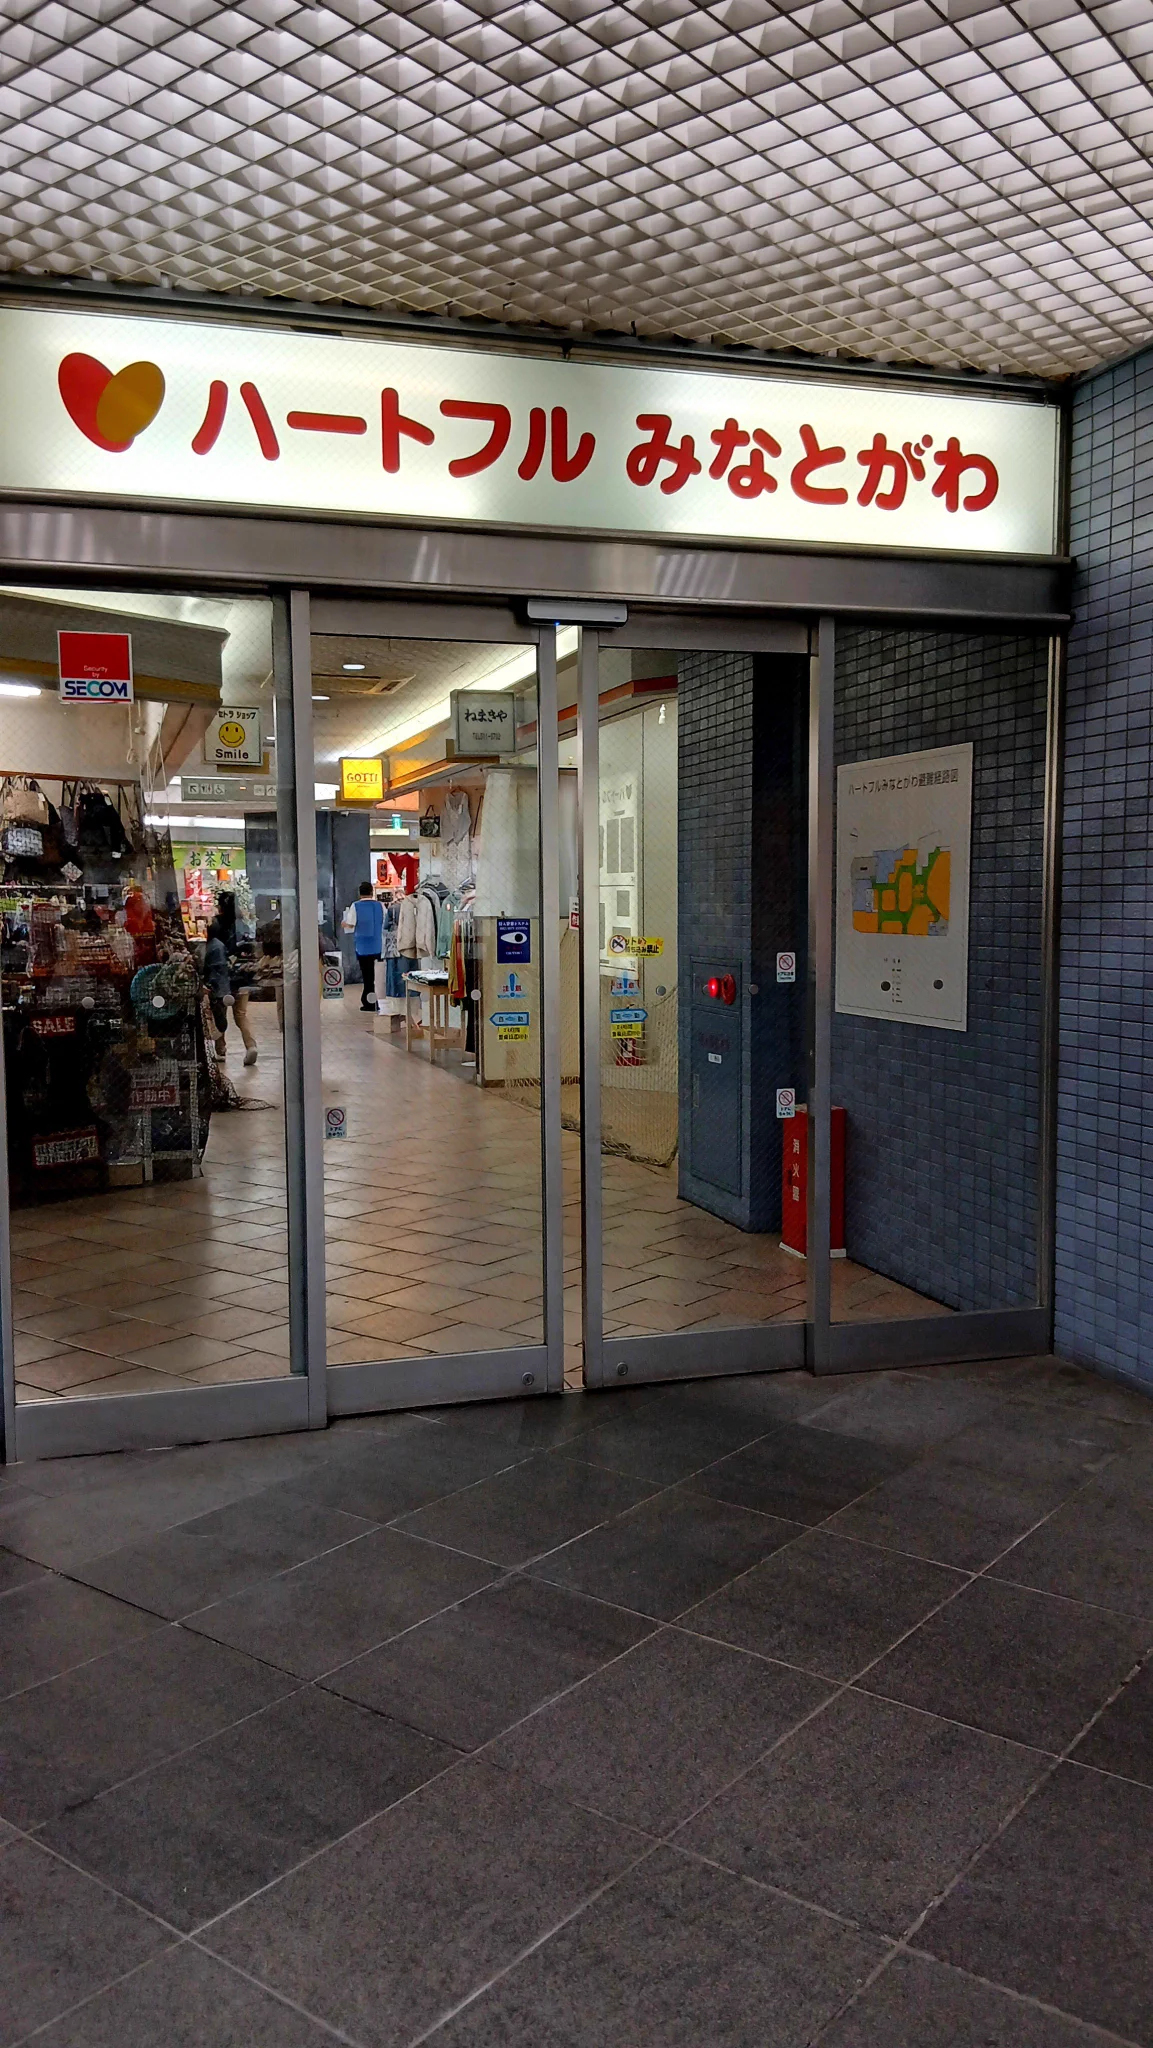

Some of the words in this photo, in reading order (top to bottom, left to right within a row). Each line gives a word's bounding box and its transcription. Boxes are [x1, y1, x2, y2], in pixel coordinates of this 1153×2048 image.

[191, 379, 595, 484] ハートフル
[625, 414, 1000, 512] みなとがわ
[83, 665, 108, 673] Security
[65, 680, 128, 697] SECOM
[217, 710, 235, 719] セトラ
[465, 709, 507, 722] ねまきや
[216, 749, 249, 759] Smile
[347, 772, 378, 782] GOTTI
[190, 851, 231, 867] お茶処
[32, 1016, 75, 1034] SALE
